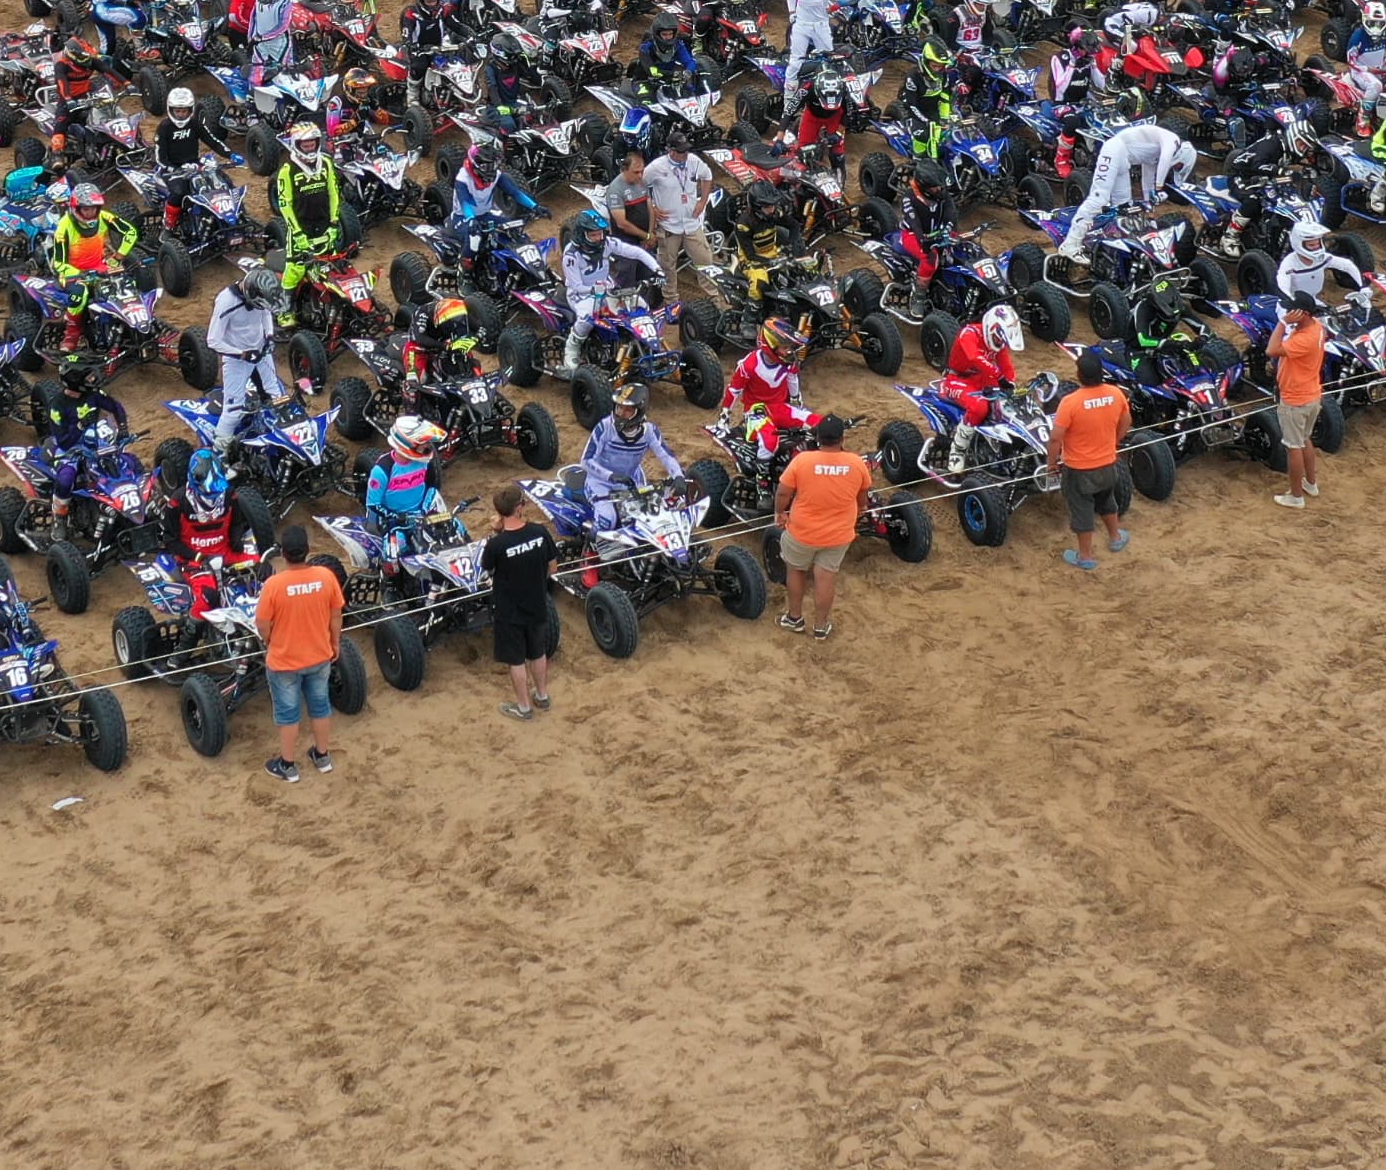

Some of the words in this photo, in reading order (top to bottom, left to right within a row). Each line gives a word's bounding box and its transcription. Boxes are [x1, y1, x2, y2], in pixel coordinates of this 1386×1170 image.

[978, 148, 992, 161] 34
[1095, 157, 1112, 181] FOX
[822, 180, 839, 192] 103
[215, 199, 234, 213] 204
[351, 288, 368, 302] 121
[817, 291, 835, 305] 29
[640, 324, 657, 338] 30
[356, 340, 374, 352] 33
[470, 389, 487, 404] 33
[1084, 397, 1114, 409] STAFF
[7, 449, 25, 461] 26
[814, 465, 850, 475] STAFF
[121, 492, 140, 510] 26
[506, 536, 544, 557] STAFF
[665, 533, 682, 551] 13
[456, 559, 472, 576] 12
[286, 581, 323, 595] STAFF
[8, 666, 28, 685] 16
